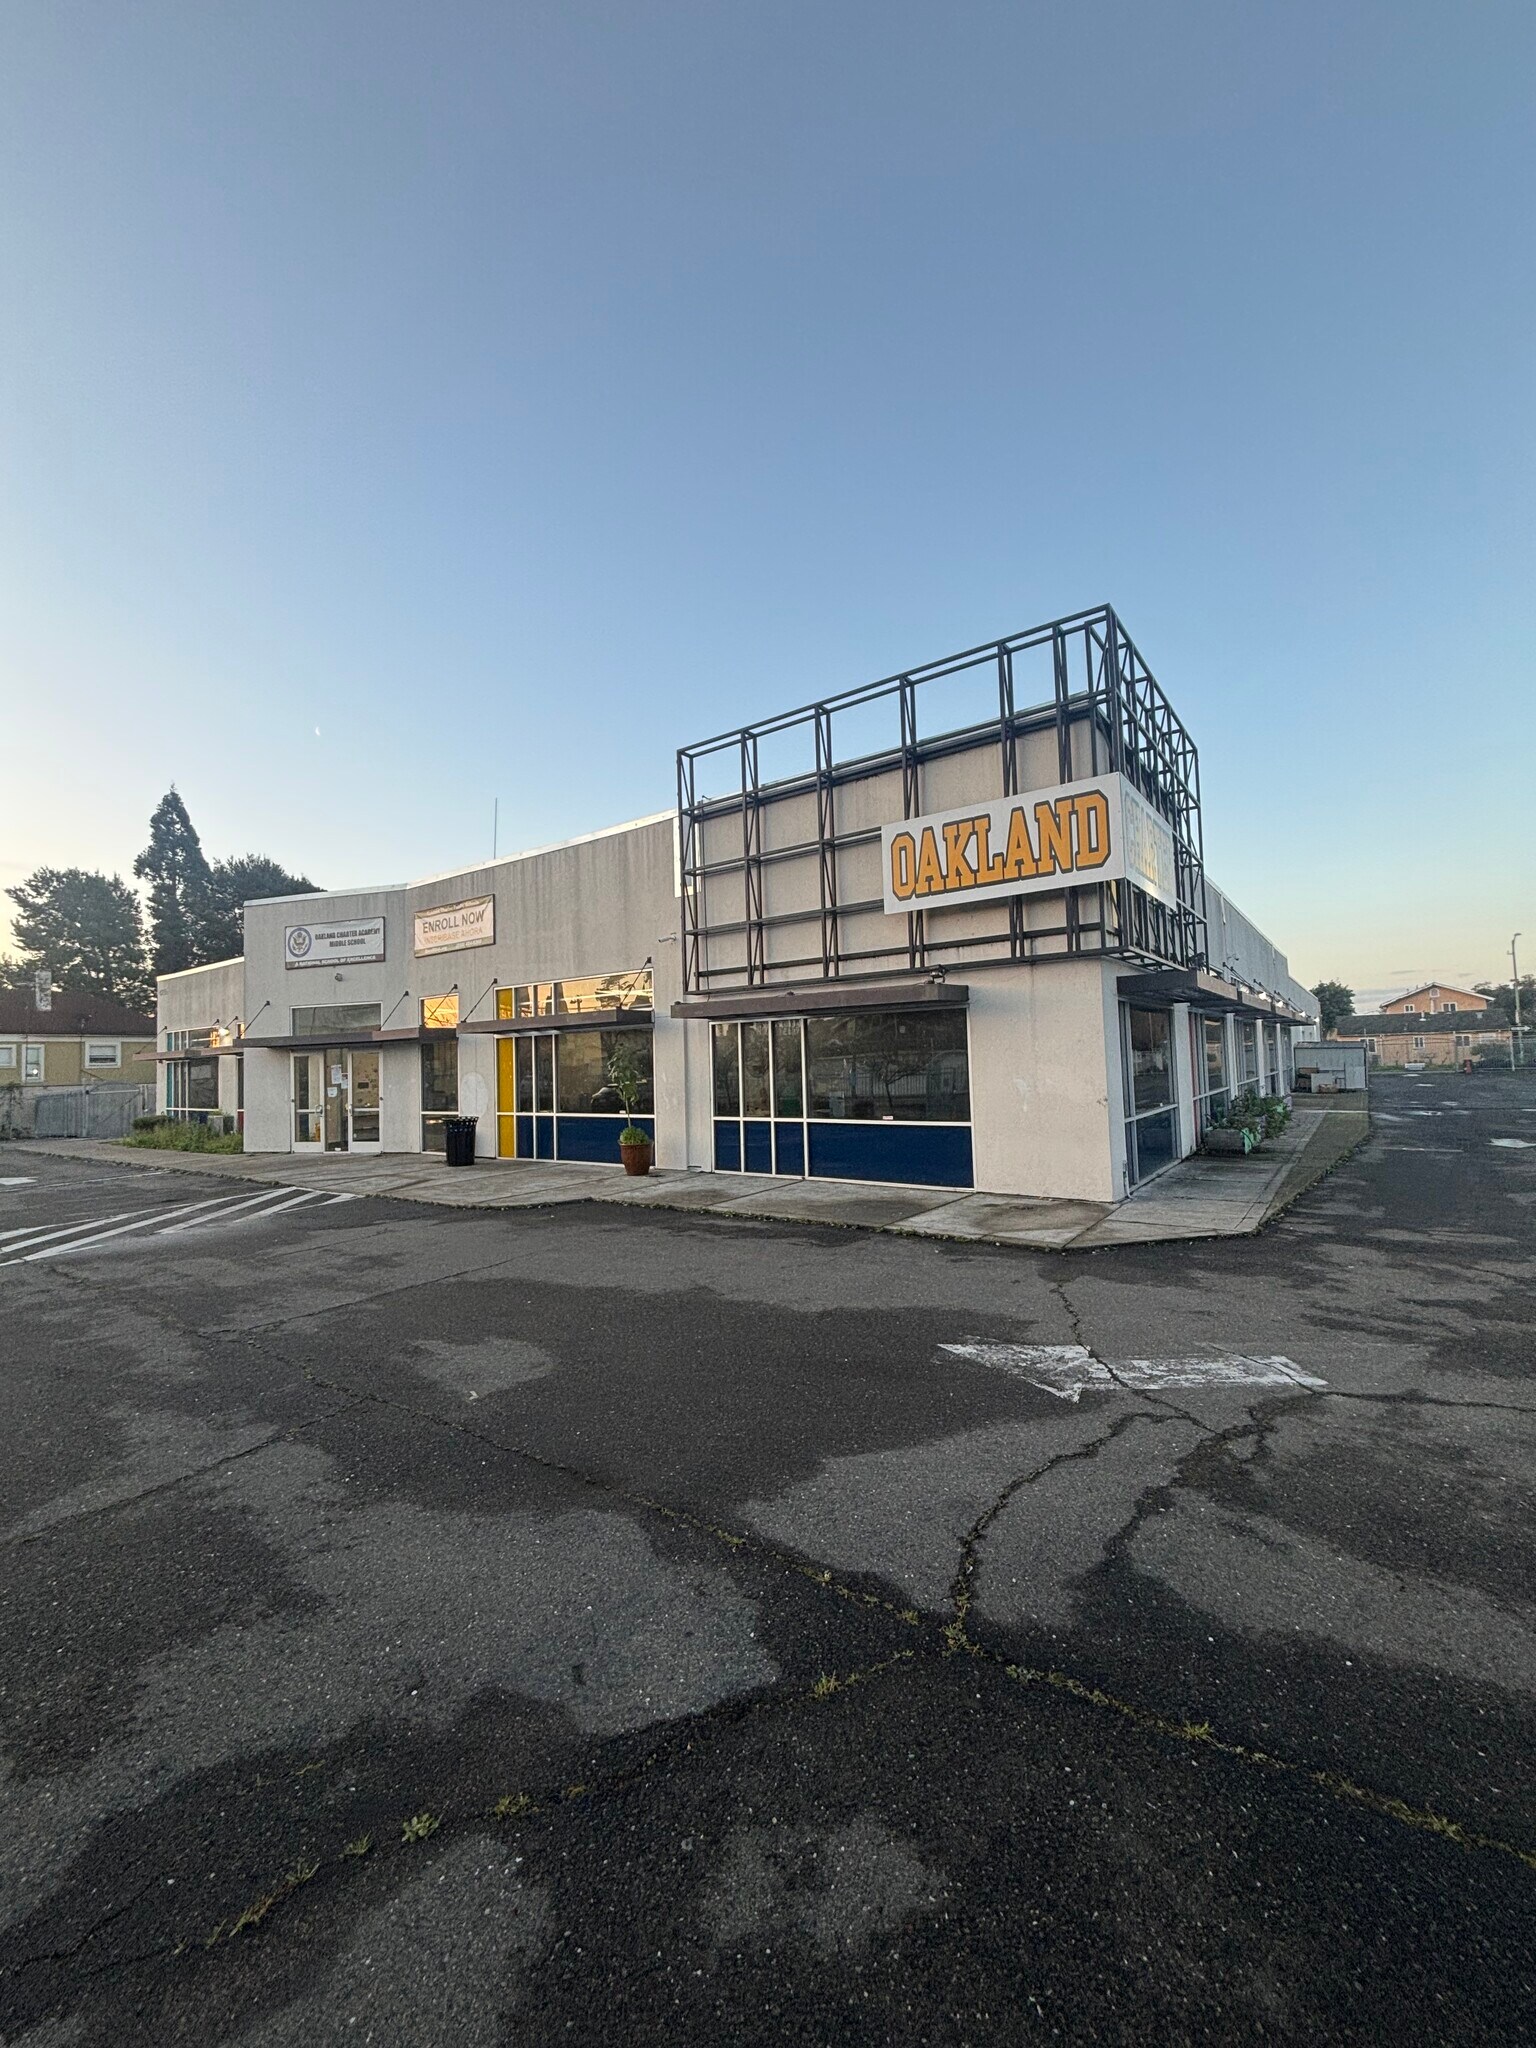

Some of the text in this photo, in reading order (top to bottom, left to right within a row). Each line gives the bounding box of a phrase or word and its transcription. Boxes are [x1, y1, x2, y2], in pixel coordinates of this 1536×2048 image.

[890, 788, 1112, 902] OAKLAND
[422, 909, 485, 934] ENROLL NOW
[314, 927, 381, 941] OAKLAND CHARTER ACADEMY
[329, 938, 366, 947] MIDDLE SCHOOL
